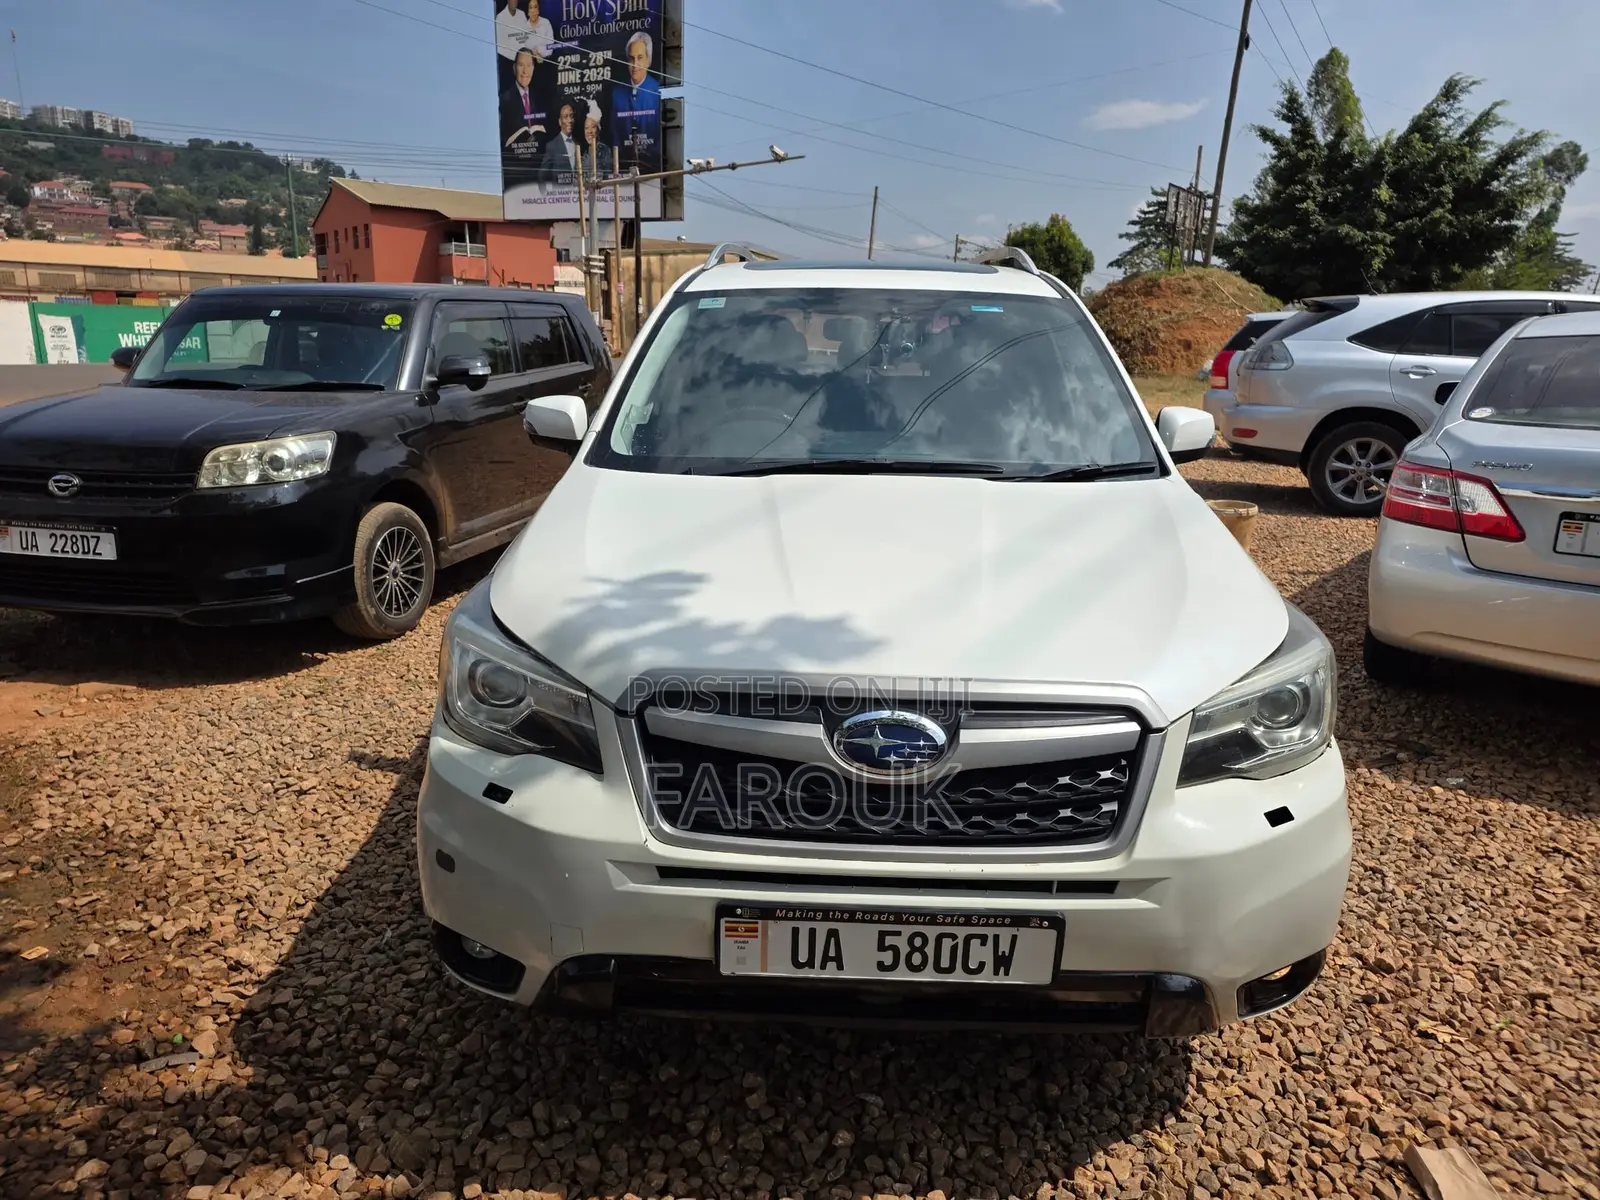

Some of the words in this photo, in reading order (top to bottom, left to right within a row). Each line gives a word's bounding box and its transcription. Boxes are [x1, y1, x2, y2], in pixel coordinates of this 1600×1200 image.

[562, 0, 601, 22] Holy
[560, 21, 592, 39] Global
[593, 17, 652, 35] Conference
[557, 70, 581, 85] JUNE
[583, 66, 612, 83] 2026
[563, 85, 581, 95] 9AM
[586, 83, 603, 93] 9PM
[118, 333, 153, 348] WHIT
[19, 530, 40, 552] UA
[49, 532, 103, 556] 228DZ
[775, 908, 824, 920] Making
[829, 911, 850, 920] the
[855, 911, 896, 921] Roads
[901, 913, 931, 922] Your
[936, 914, 965, 923] Safe
[970, 915, 1012, 925] Space
[790, 926, 845, 971] UA
[876, 929, 1019, 977] 580CW
